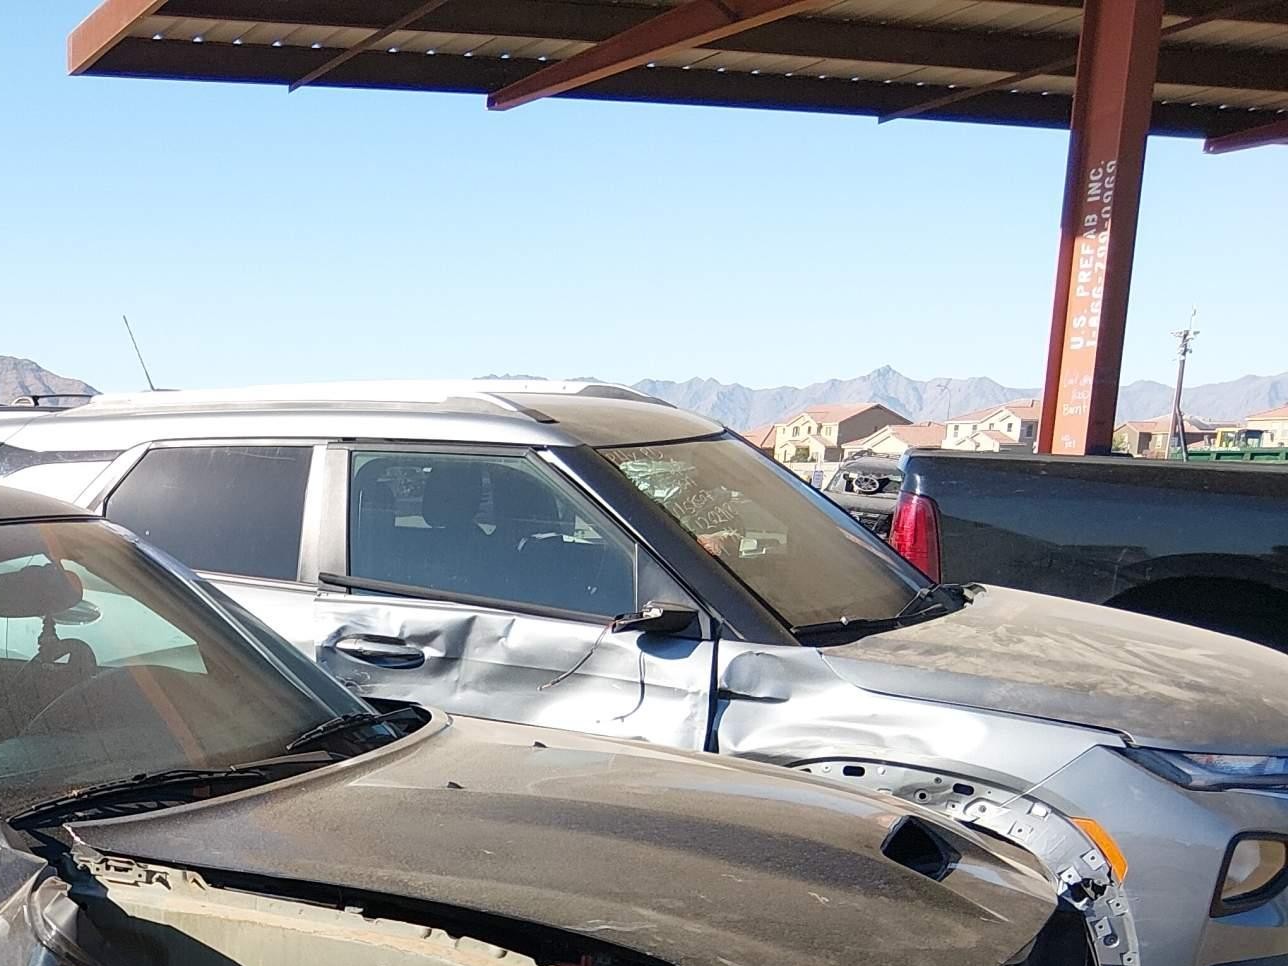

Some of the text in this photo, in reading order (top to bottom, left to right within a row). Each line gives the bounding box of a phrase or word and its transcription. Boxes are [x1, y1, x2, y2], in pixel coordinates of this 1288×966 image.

[1069, 161, 1104, 350] U.S. PREFAB INC.
